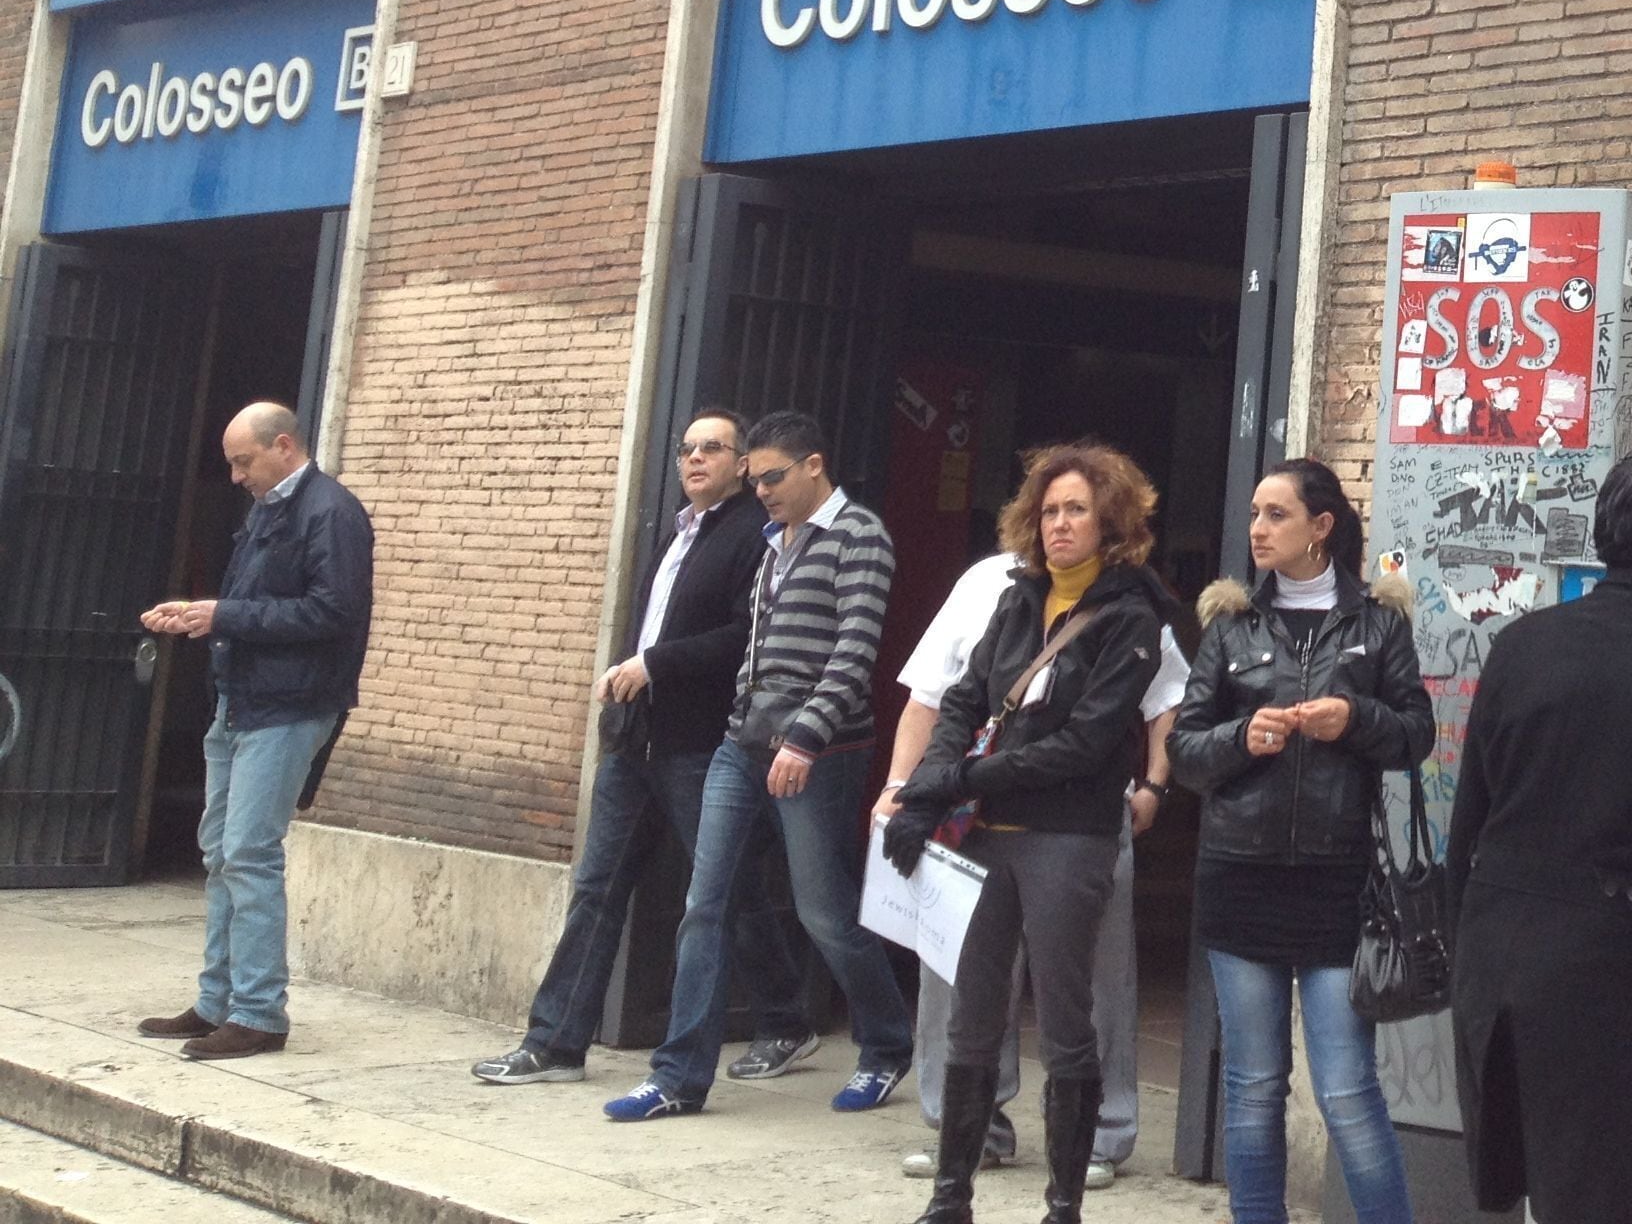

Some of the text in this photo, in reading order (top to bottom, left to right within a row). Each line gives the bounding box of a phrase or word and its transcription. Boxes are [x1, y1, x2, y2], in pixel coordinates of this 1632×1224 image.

[81, 45, 372, 147] Colosseo B
[386, 55, 407, 86] 21
[1423, 286, 1561, 370] SOS
